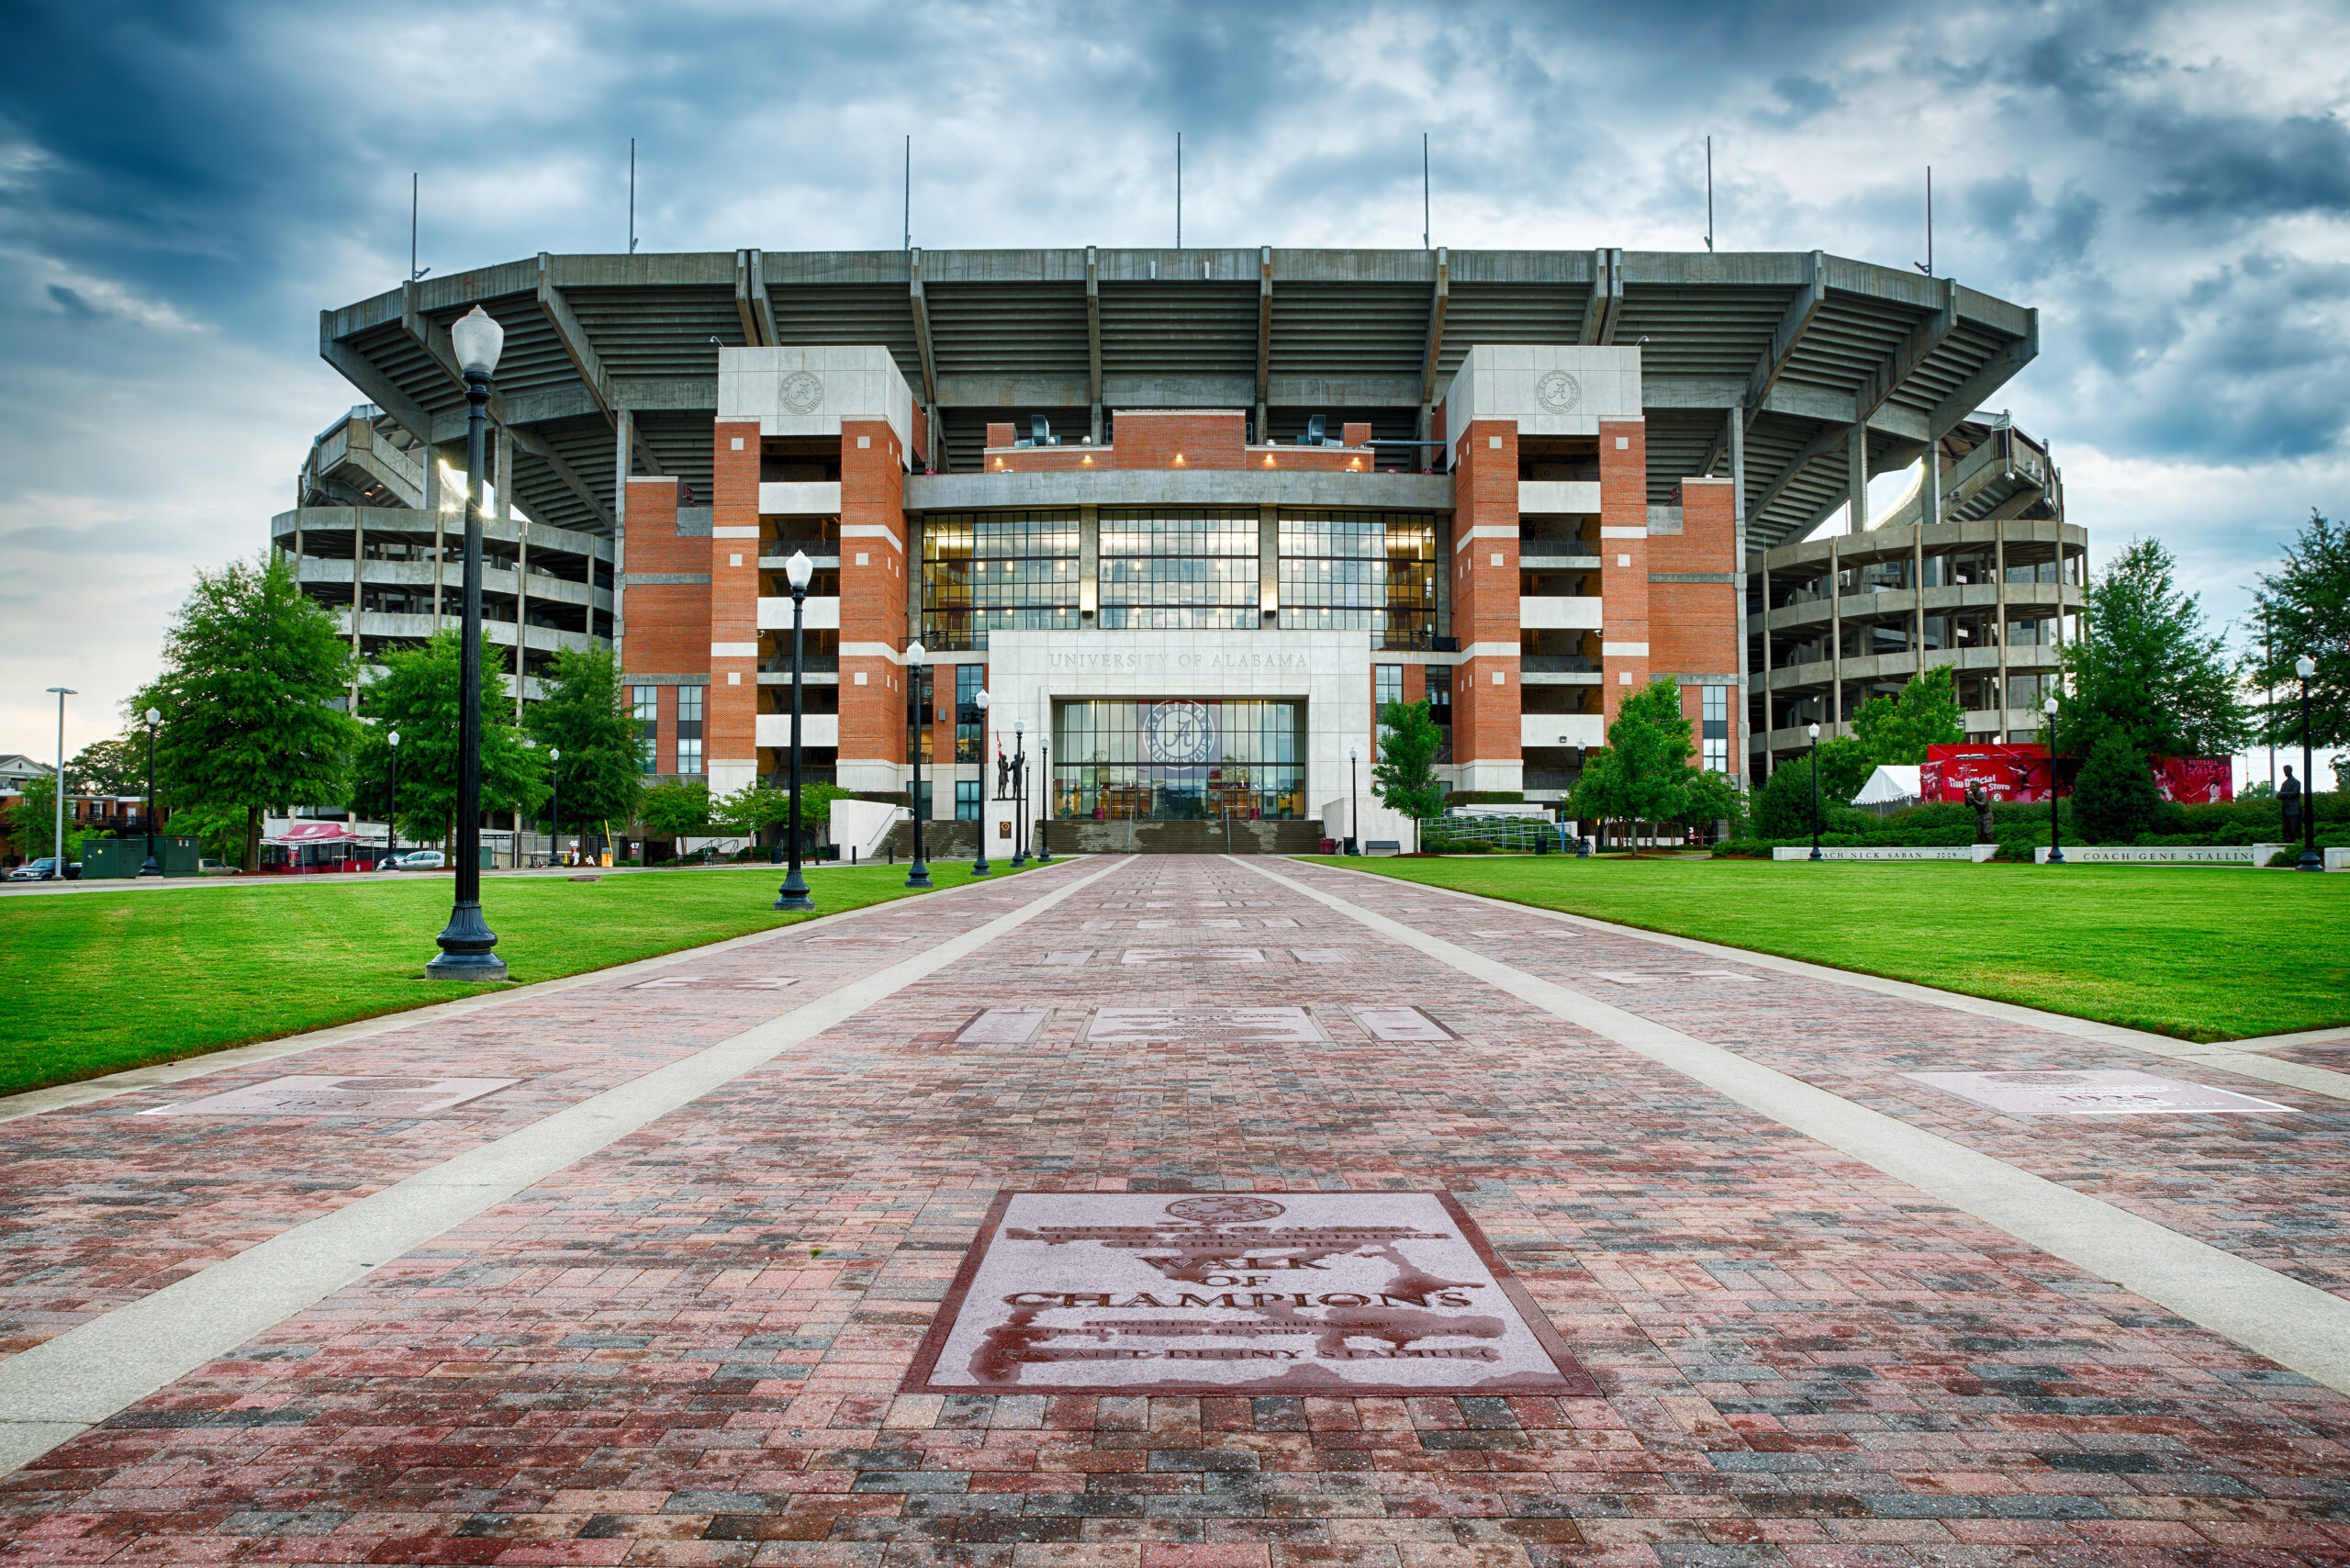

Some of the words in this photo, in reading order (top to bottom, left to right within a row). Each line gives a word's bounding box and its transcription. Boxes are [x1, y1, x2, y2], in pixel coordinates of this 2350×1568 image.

[1049, 653, 1169, 667] UNIVERSITY
[1178, 653, 1203, 667] OF
[1211, 653, 1308, 667] ALABAMA
[1147, 701, 1210, 730] ALABAMA
[1947, 777, 1964, 789] The
[1989, 782, 2010, 791] Store
[1135, 1256, 1329, 1271] WALK
[1198, 1275, 1270, 1287] OF
[1002, 1292, 1473, 1308] CHAMPIONS
[999, 1349, 1303, 1360] BRYANT-DENNY
[1317, 1349, 1494, 1360] STADIUM
